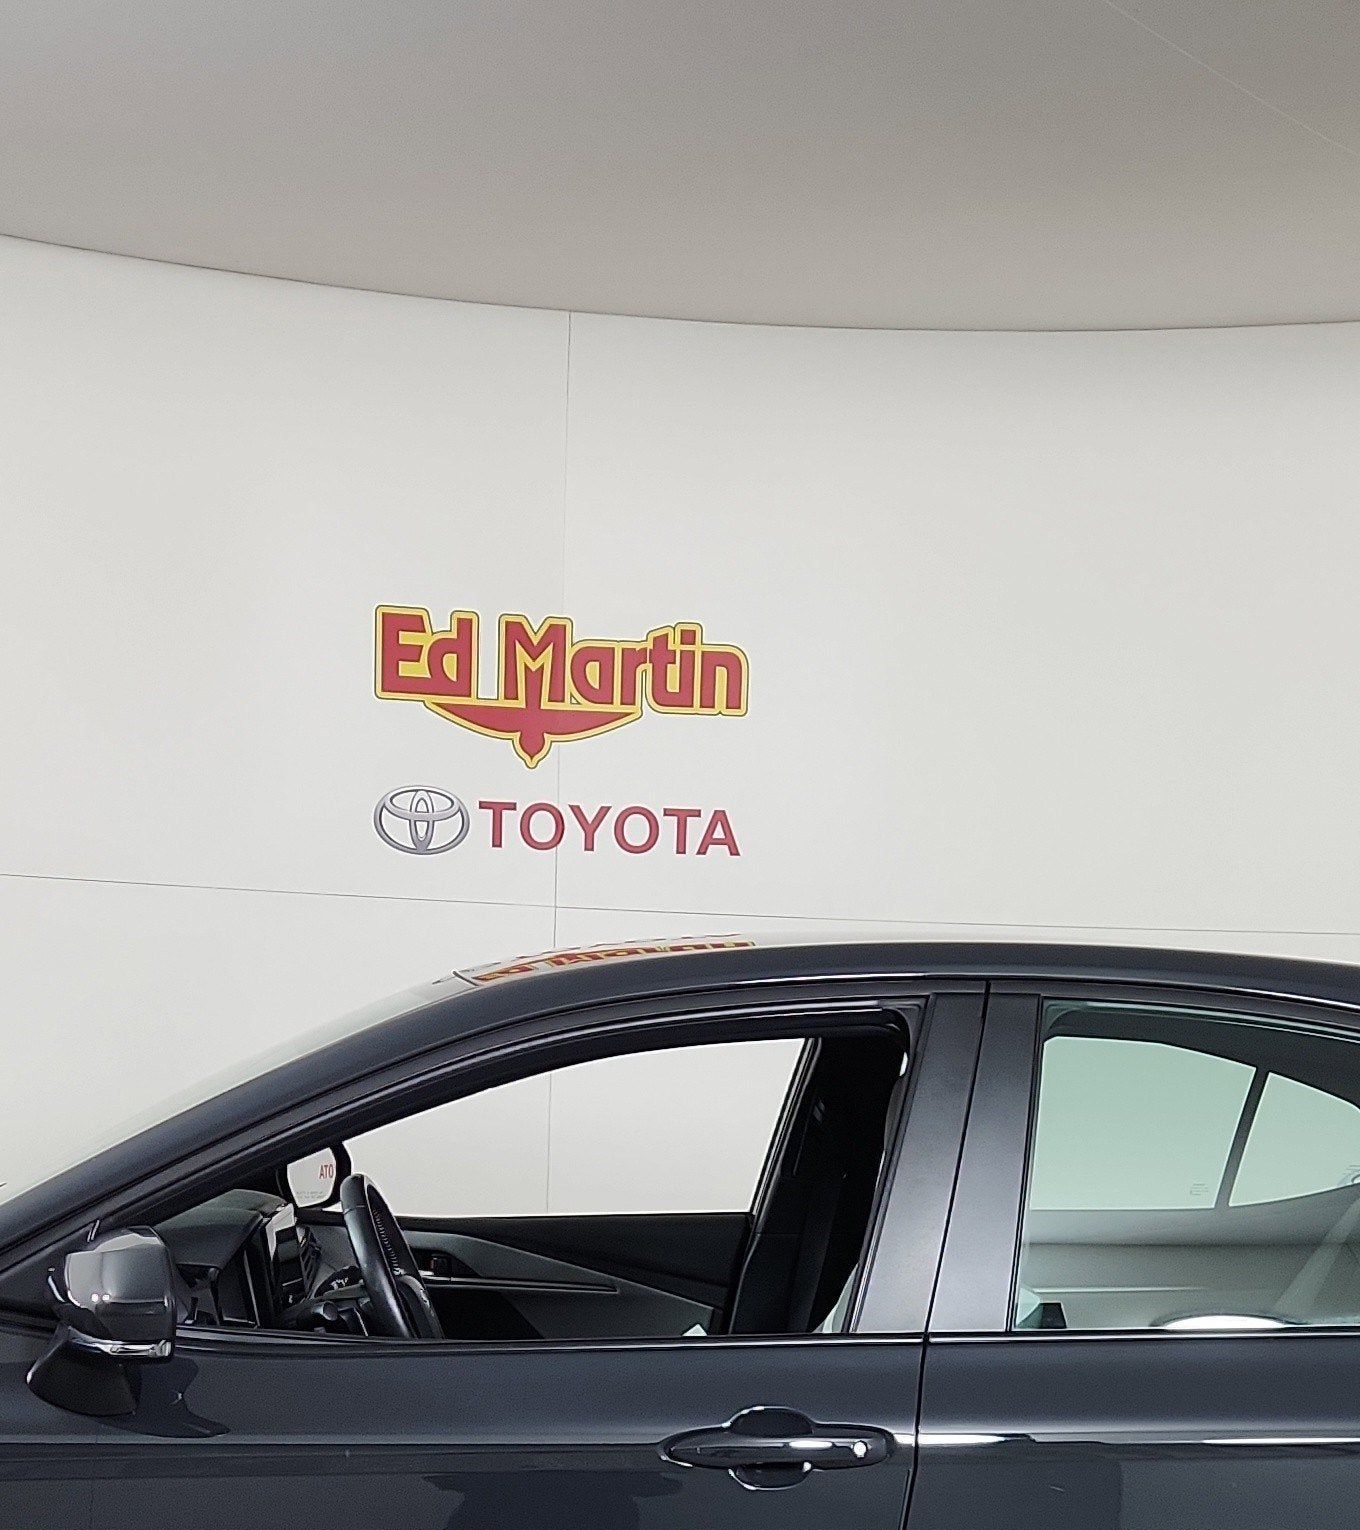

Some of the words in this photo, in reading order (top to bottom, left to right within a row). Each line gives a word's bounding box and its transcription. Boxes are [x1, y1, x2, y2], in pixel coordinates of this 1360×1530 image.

[376, 606, 480, 704] Ed
[499, 613, 750, 716] Martin
[478, 799, 742, 857] TOYOTA
